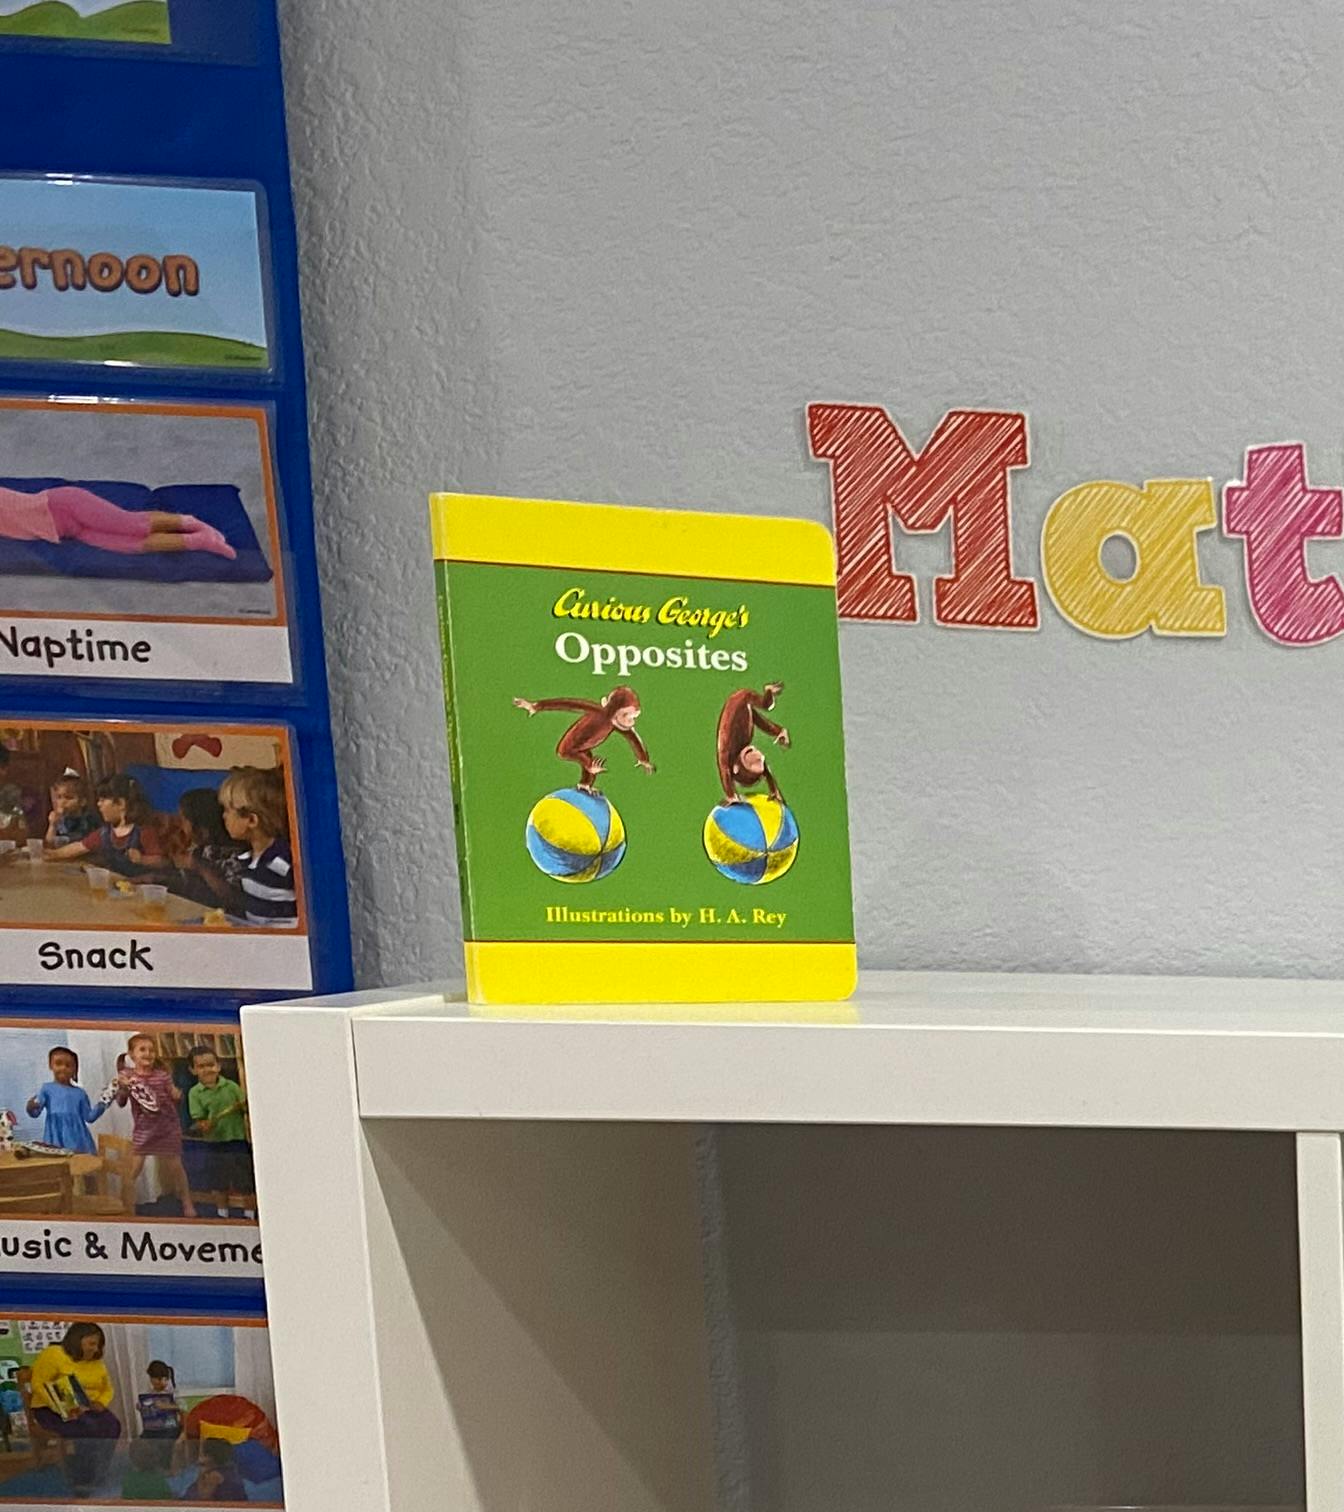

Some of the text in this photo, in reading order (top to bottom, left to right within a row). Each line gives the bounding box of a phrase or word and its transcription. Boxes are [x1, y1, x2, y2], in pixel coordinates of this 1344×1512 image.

[551, 586, 750, 639] Curious George's
[0, 626, 152, 668] Naptime
[554, 632, 749, 677] Opposites
[546, 905, 787, 930] Illustrations by H. A. Rey
[38, 939, 154, 972] Snack
[0, 1229, 72, 1259] usic
[85, 1231, 109, 1260] &
